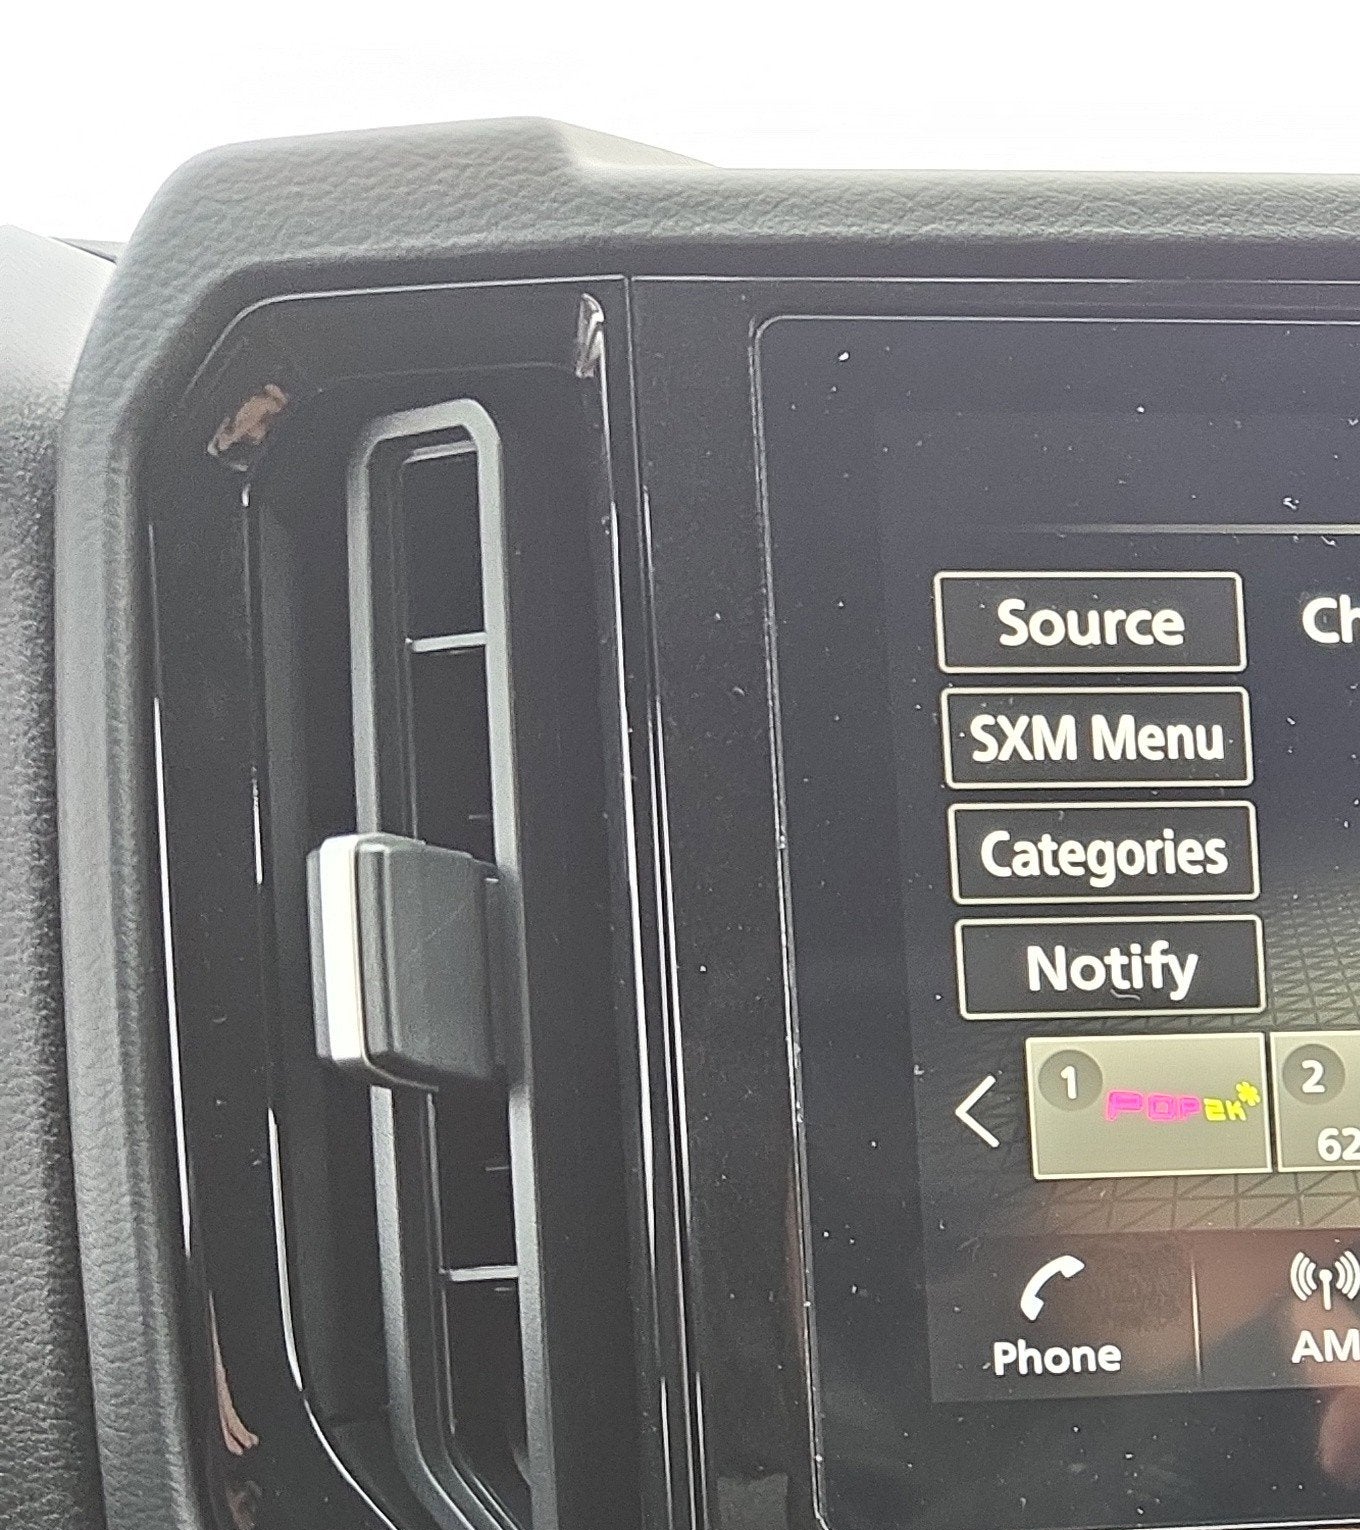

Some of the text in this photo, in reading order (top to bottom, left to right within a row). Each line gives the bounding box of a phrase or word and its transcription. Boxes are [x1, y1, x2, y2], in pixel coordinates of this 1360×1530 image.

[999, 599, 1185, 646] Source
[969, 714, 1225, 762] SXM Menu
[980, 829, 1229, 888] Categories
[1026, 940, 1198, 998] Notify
[1061, 1067, 1078, 1099] 1
[1301, 1060, 1325, 1093] 2
[993, 1340, 1121, 1378] Phone
[1291, 1329, 1360, 1363] AM
